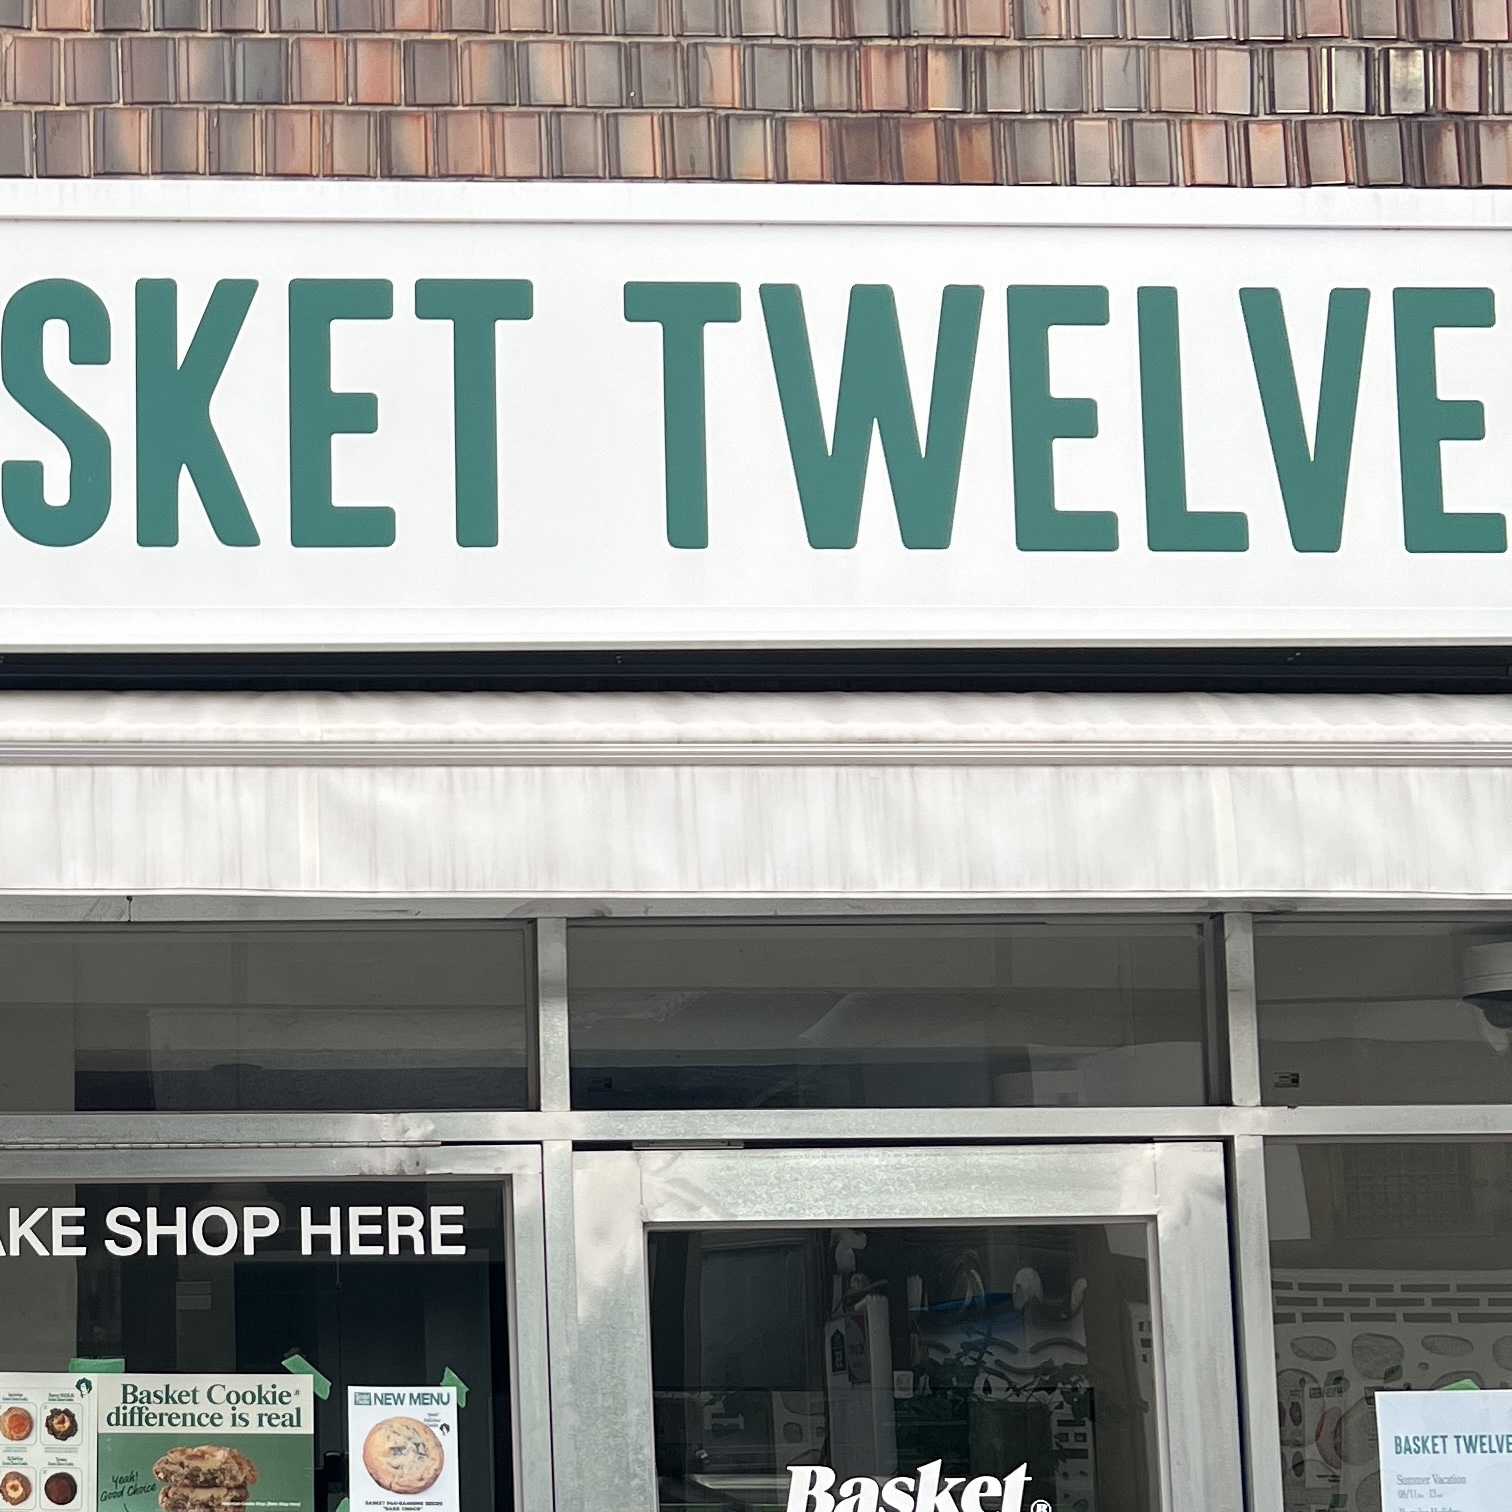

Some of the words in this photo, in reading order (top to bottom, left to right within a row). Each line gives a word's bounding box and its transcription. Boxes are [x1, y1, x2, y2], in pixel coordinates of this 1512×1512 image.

[623, 281, 1508, 553] TWELVE
[105, 1207, 279, 1256] SHOP
[301, 1206, 466, 1255] HERE
[121, 1383, 200, 1405] Basket
[206, 1383, 292, 1405] Cookie
[374, 1392, 406, 1406] NEW
[409, 1392, 450, 1406] MENU
[106, 1406, 223, 1427] difference
[231, 1406, 249, 1427] is
[257, 1407, 302, 1428] real
[1394, 1435, 1448, 1455] BASKET
[1454, 1434, 1512, 1454] TWELVE
[1397, 1474, 1430, 1485] Summer
[1432, 1474, 1466, 1485] Vacation
